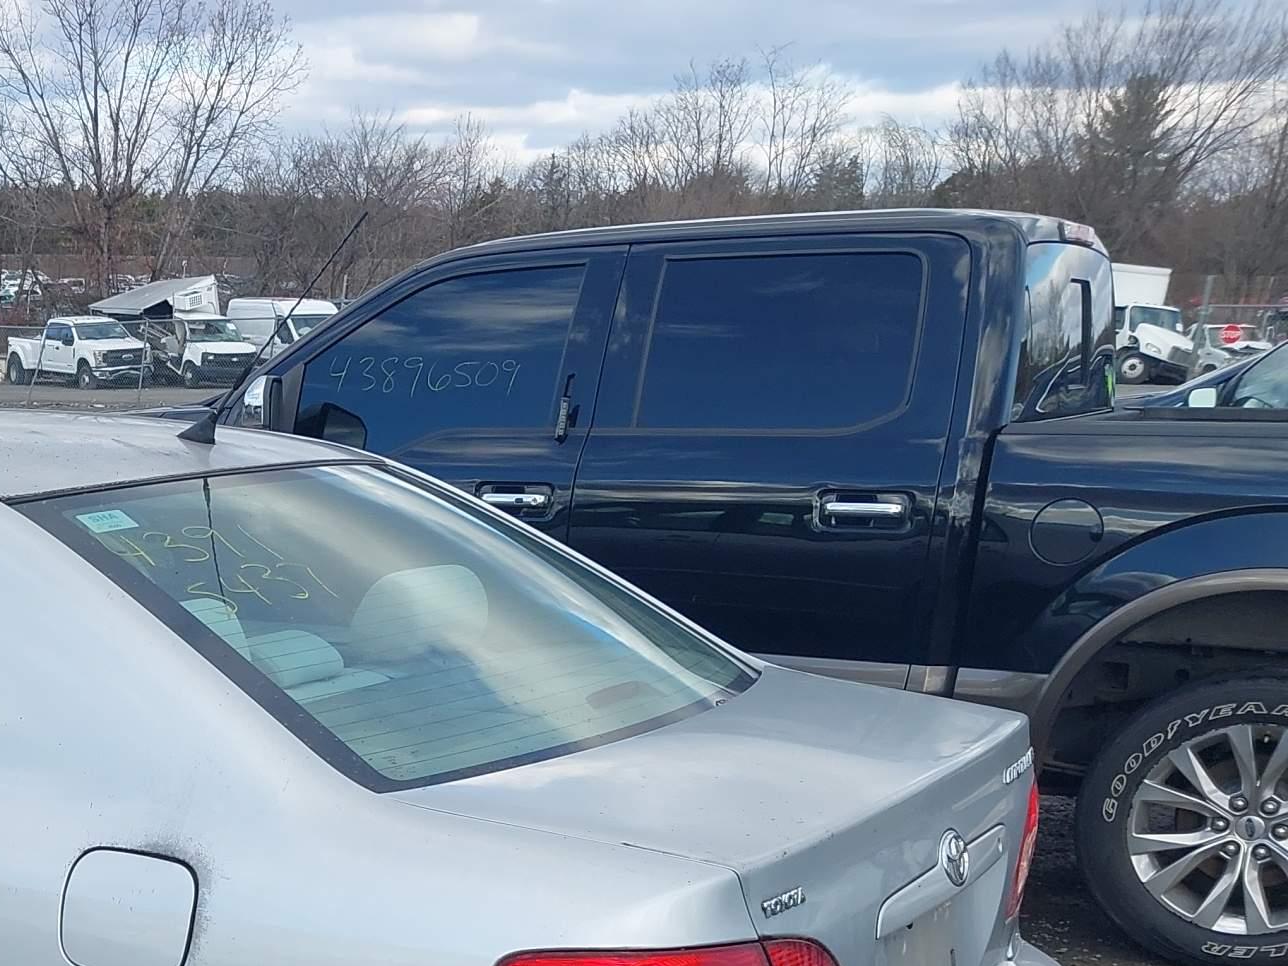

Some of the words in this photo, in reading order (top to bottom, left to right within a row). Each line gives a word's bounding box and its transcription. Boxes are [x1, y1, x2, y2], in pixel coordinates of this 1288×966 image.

[328, 356, 521, 397] 43896509
[90, 525, 284, 567] 4391
[761, 887, 806, 919] TOYOTA
